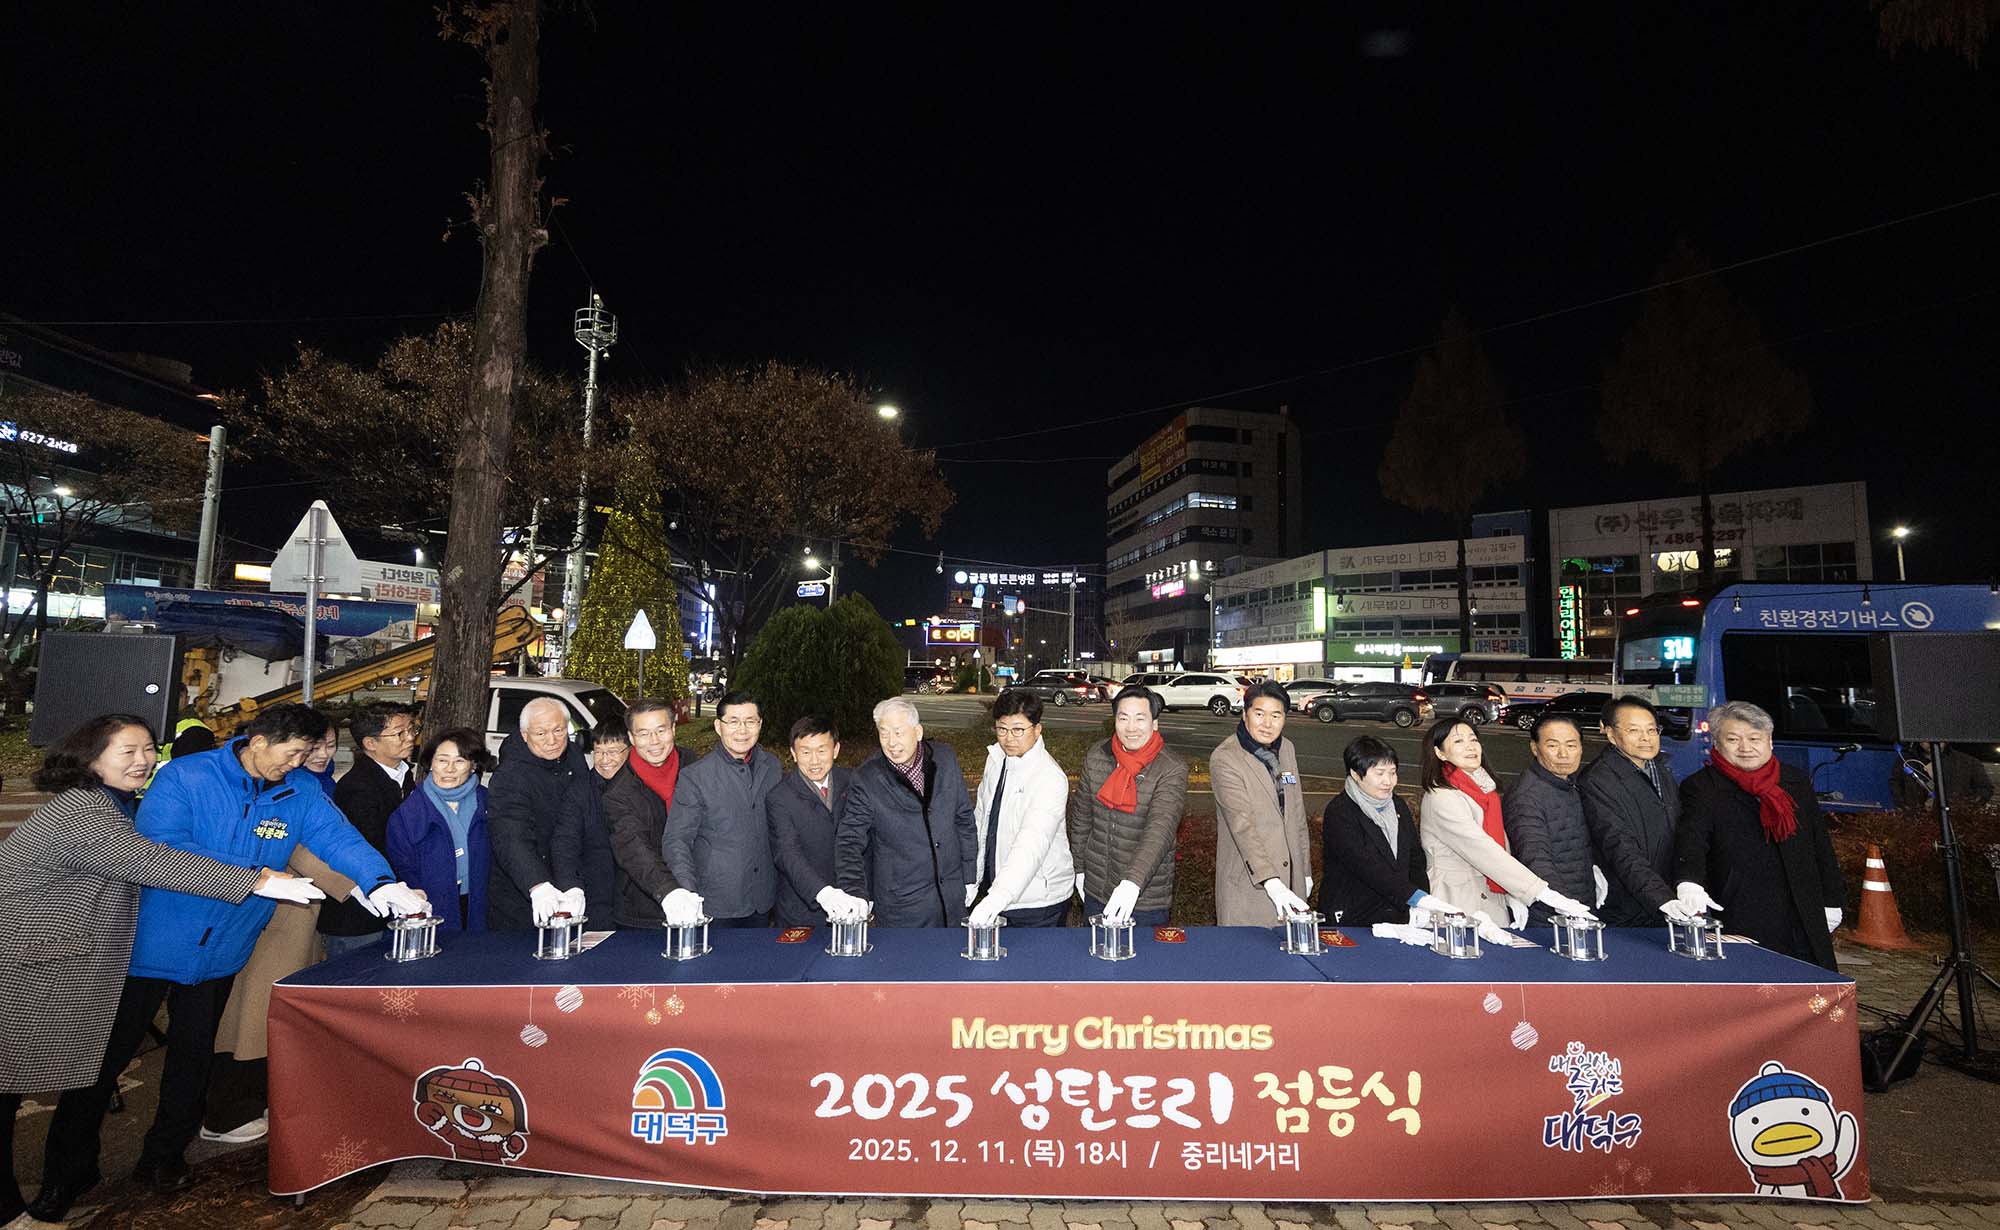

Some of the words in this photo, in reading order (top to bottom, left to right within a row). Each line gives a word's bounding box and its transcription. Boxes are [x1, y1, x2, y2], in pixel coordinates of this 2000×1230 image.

[1664, 529, 1746, 544] 486-297
[1760, 609, 1900, 628] 친환경전기버스
[1664, 638, 1694, 660] 314
[951, 1016, 1066, 1056] Merry
[1074, 1014, 1274, 1052] Christmas
[1549, 1054, 1570, 1073] 내
[1576, 1052, 1622, 1077] 일상이
[810, 1072, 974, 1126] 2025
[990, 1068, 1234, 1132] 성탄트리
[1256, 1070, 1422, 1138] 점등식
[1566, 1066, 1624, 1116] 즐거운
[631, 1112, 728, 1145] 대덕구
[1543, 1111, 1642, 1154] 대덕구
[848, 1138, 919, 1164] 2025.
[930, 1140, 968, 1164] 12.
[978, 1140, 1015, 1164] 11.
[1024, 1140, 1064, 1169] (목)
[1074, 1140, 1128, 1169] 18시
[1148, 1140, 1160, 1169] /
[1180, 1142, 1301, 1172] 중리네거리
